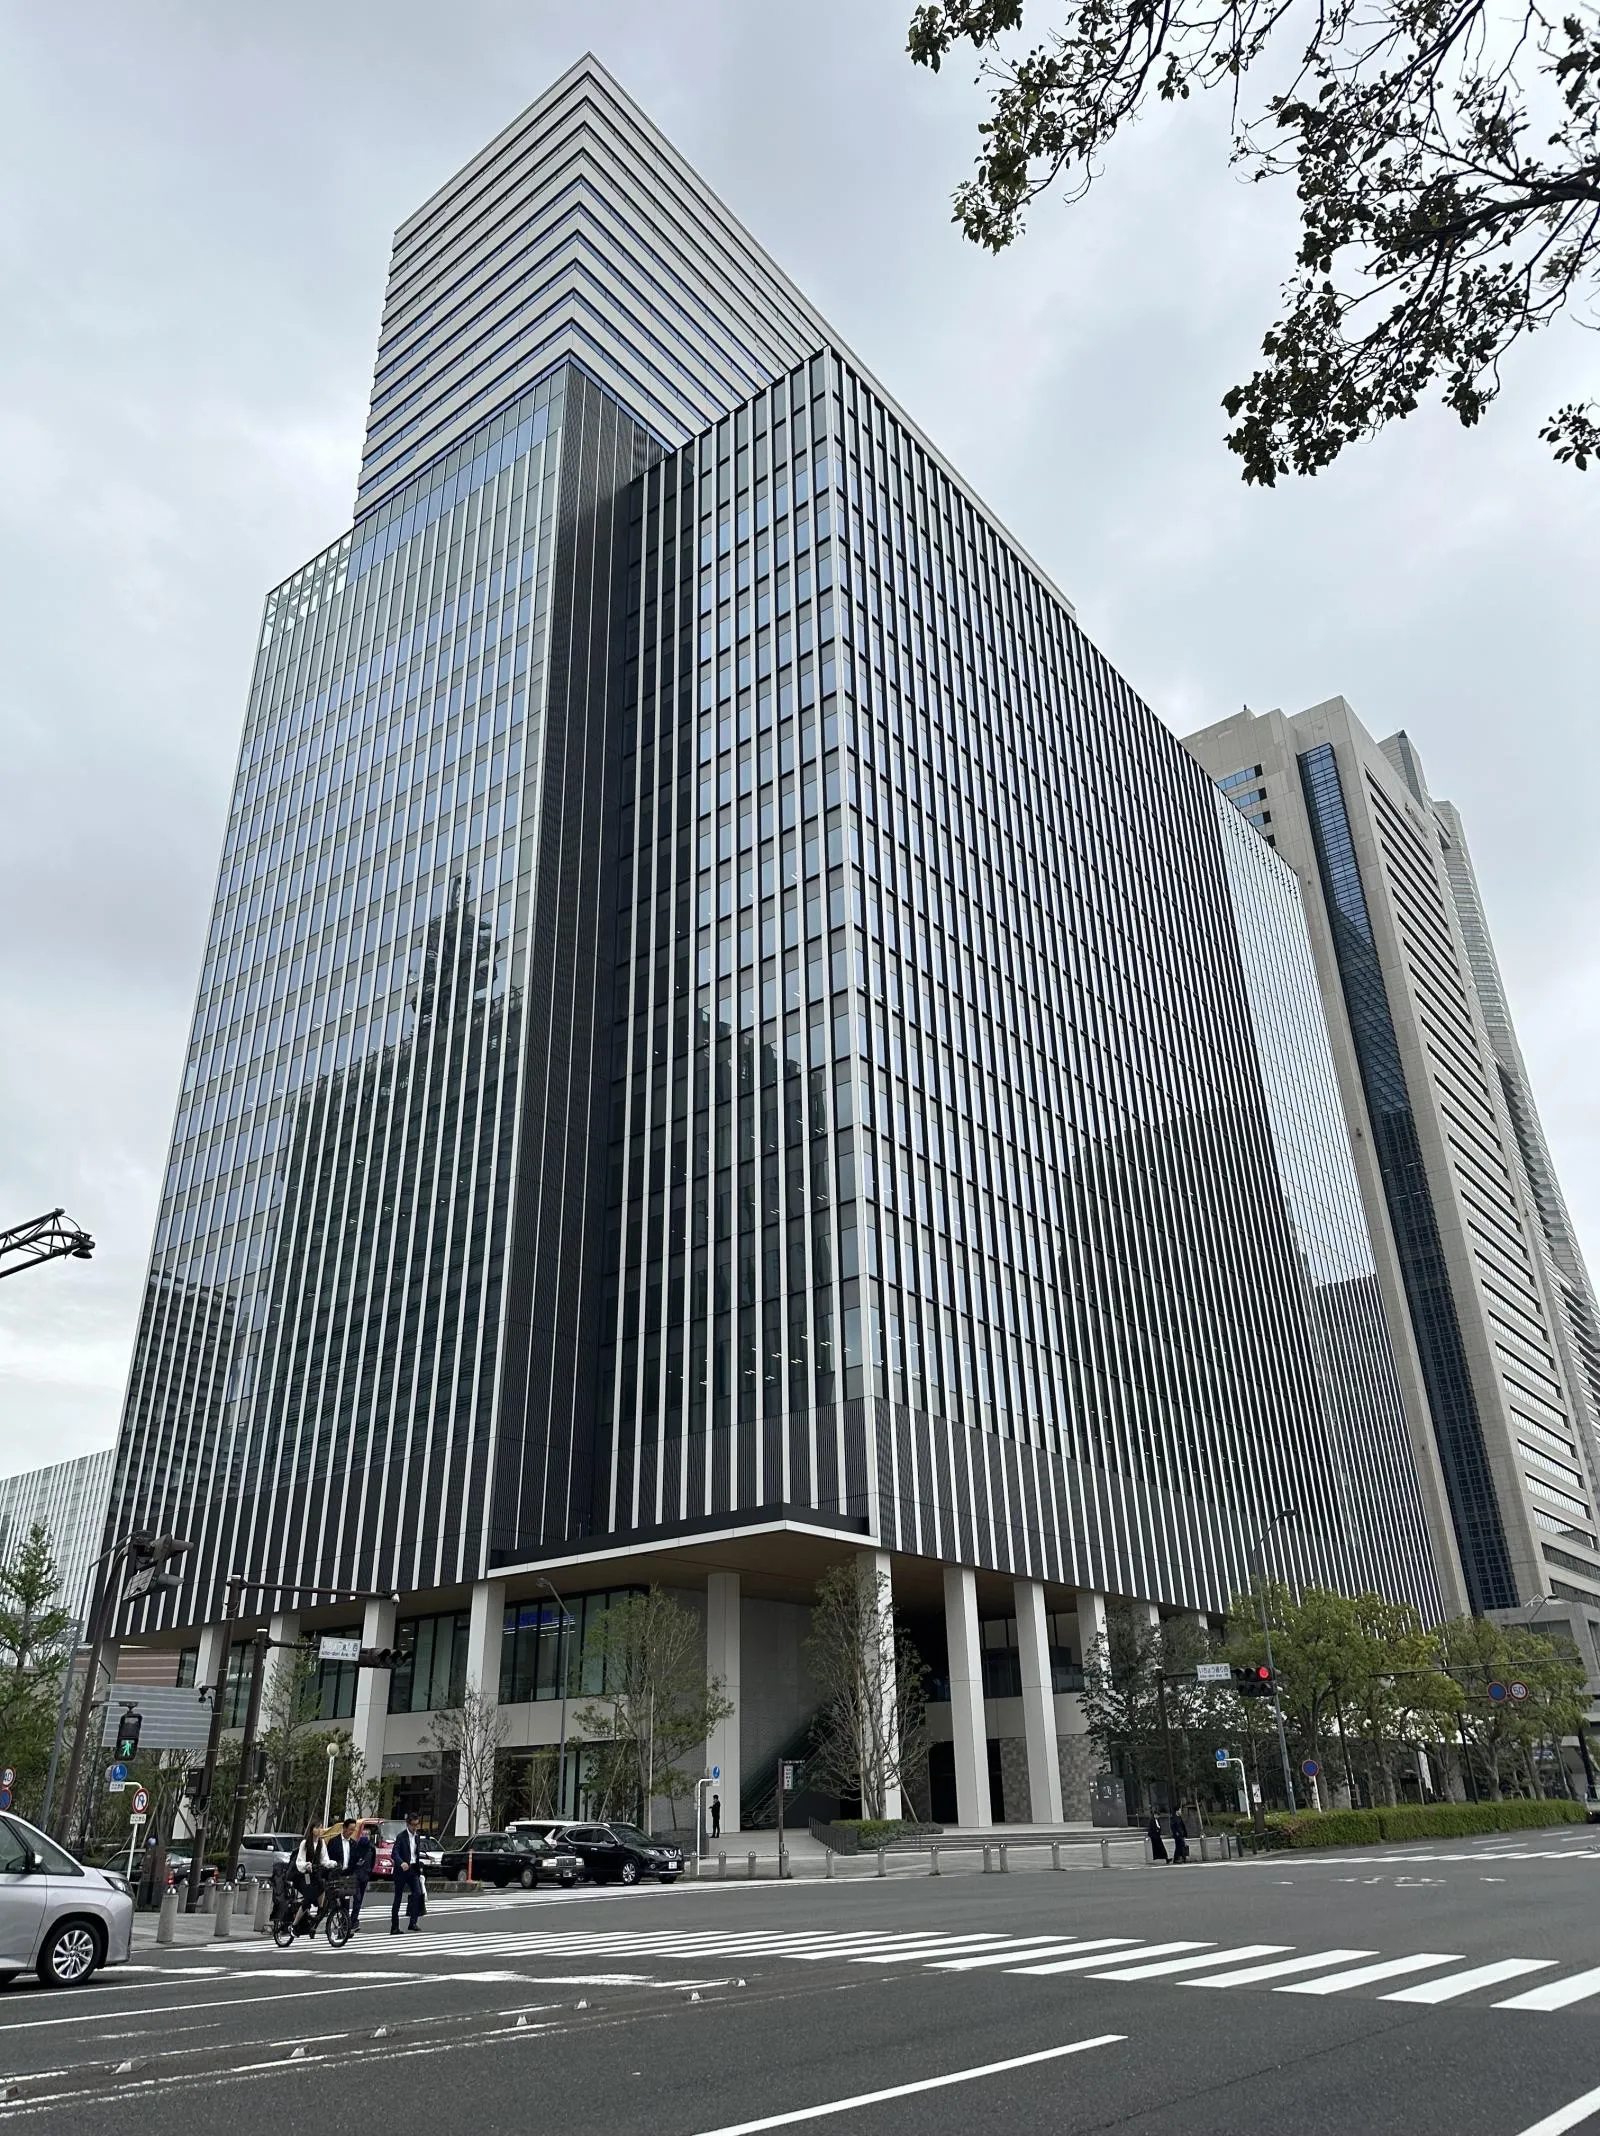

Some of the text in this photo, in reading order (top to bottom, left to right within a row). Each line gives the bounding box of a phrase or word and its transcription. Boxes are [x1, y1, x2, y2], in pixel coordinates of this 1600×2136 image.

[322, 1641, 358, 1652] い通り西
[1513, 1686, 1525, 1696] 50
